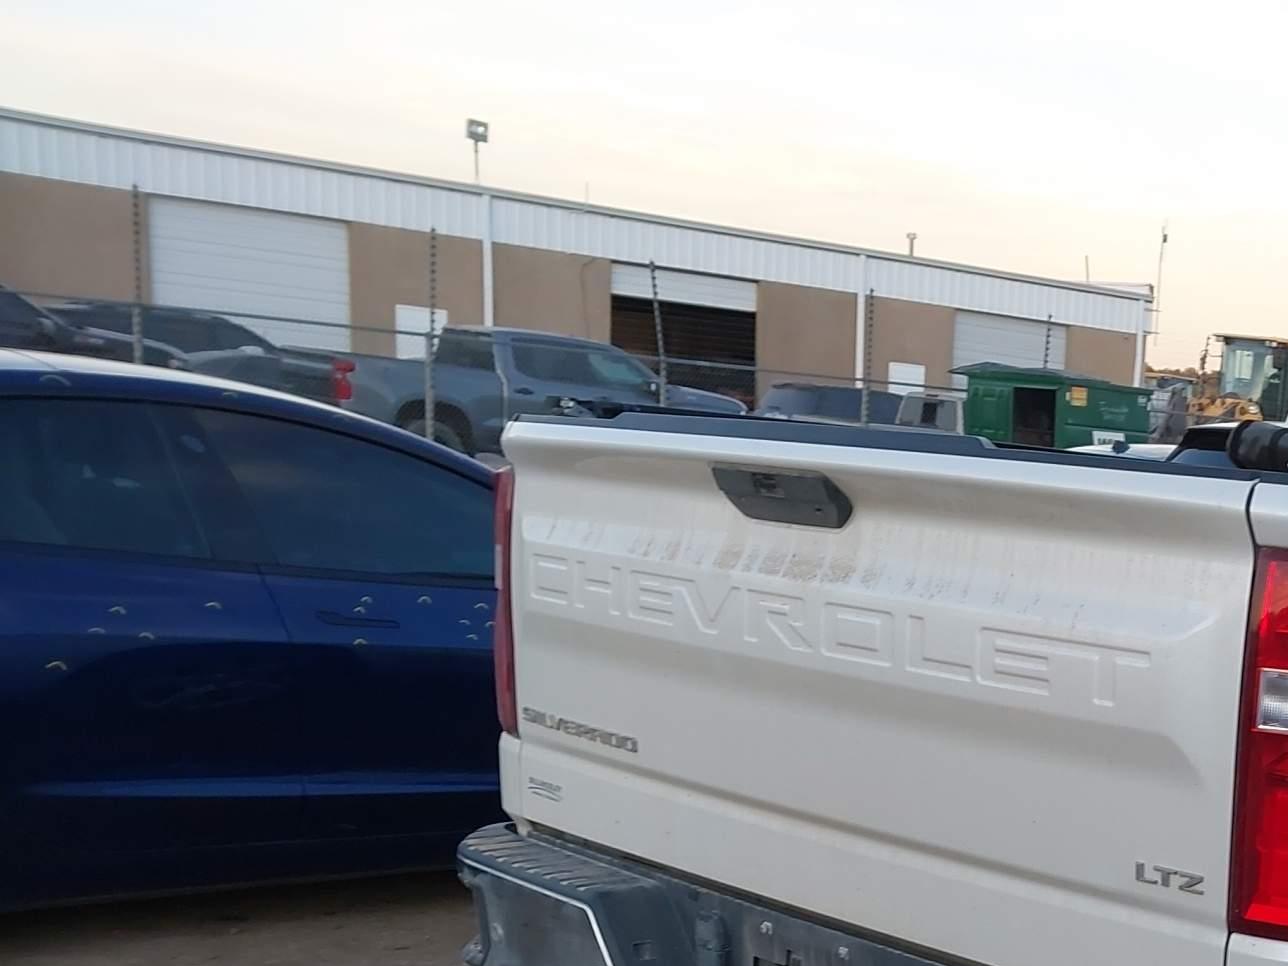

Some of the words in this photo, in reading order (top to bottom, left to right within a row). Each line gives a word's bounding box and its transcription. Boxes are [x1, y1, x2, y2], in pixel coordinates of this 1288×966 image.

[529, 553, 1152, 706] CHEVROLET
[522, 706, 638, 753] SILVERADO
[1136, 861, 1204, 895] LTZ
